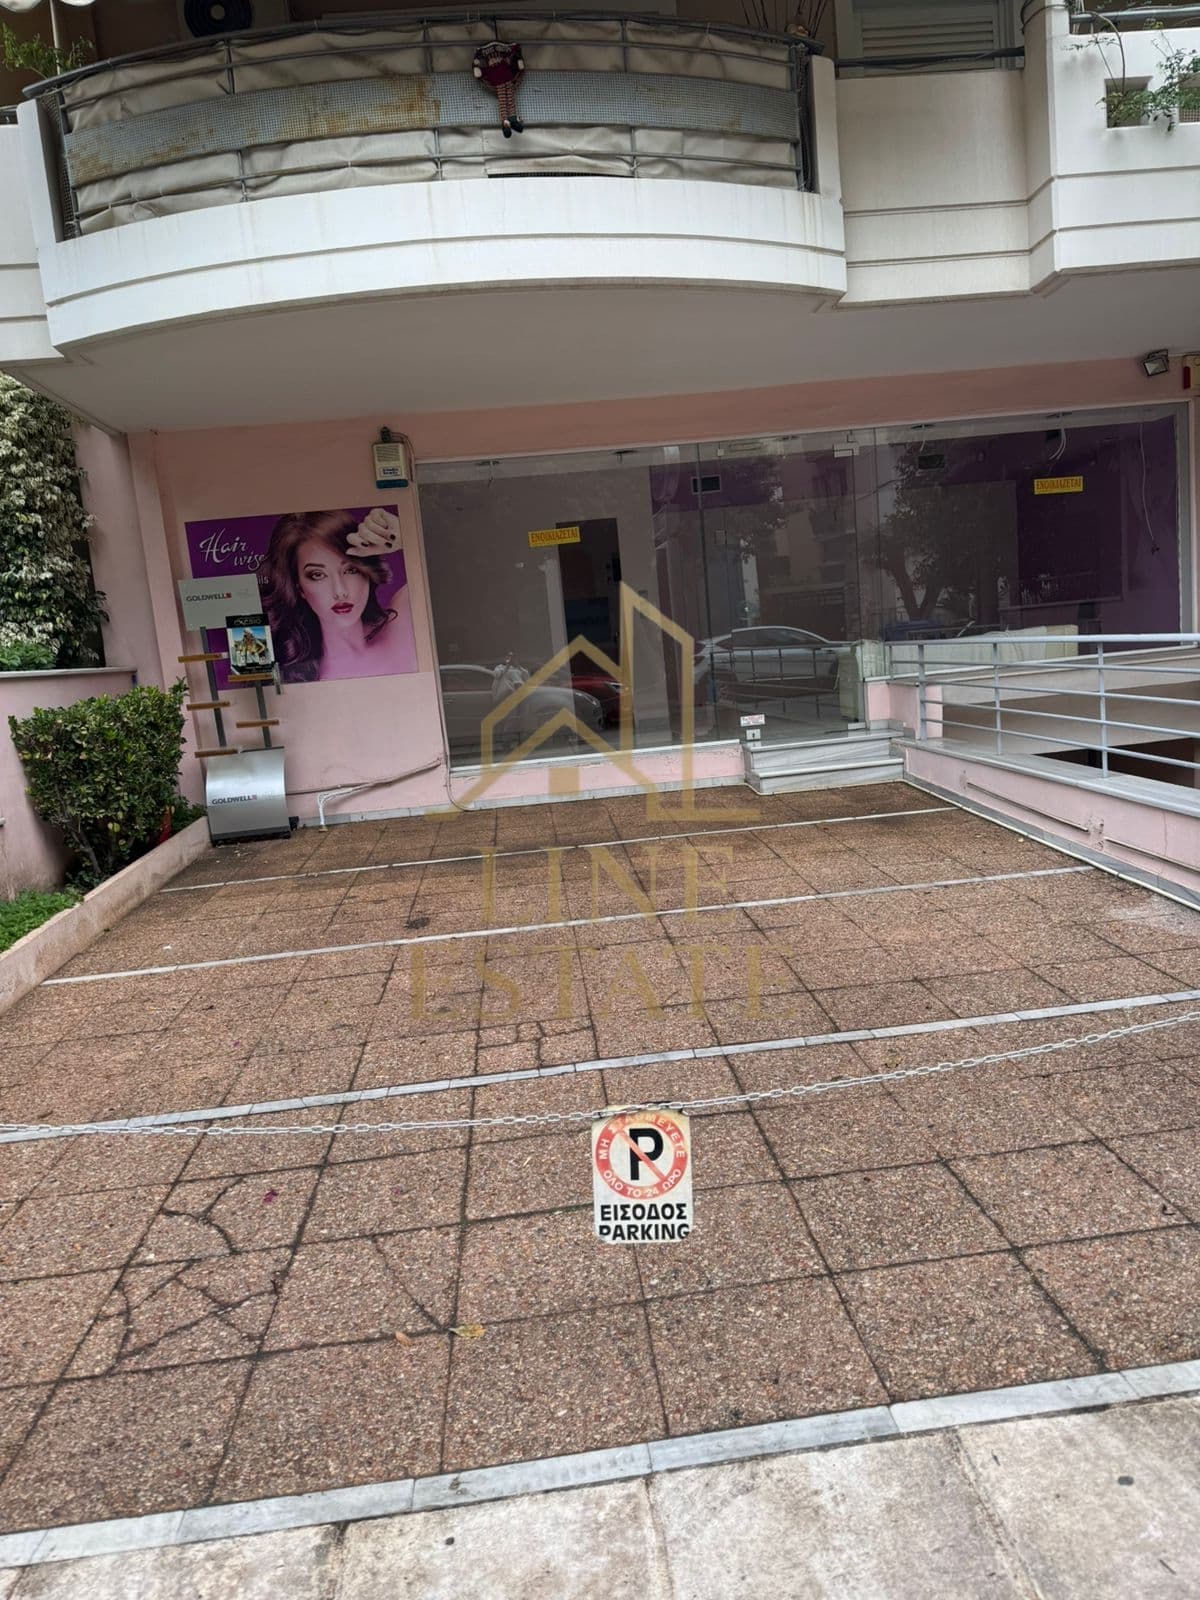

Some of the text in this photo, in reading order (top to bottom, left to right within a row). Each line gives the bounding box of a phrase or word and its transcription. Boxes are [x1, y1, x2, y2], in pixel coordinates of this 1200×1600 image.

[199, 528, 247, 563] Hair
[186, 592, 225, 602] GOLDWELL
[212, 795, 252, 804] GOLDWELL
[629, 1128, 664, 1181] P
[604, 1170, 624, 1190] ΟΛΟ
[626, 1187, 641, 1198] ΤΟ
[600, 1203, 687, 1221] ΕΙΣΟΔΟΣ
[598, 1223, 690, 1241] PARKING
